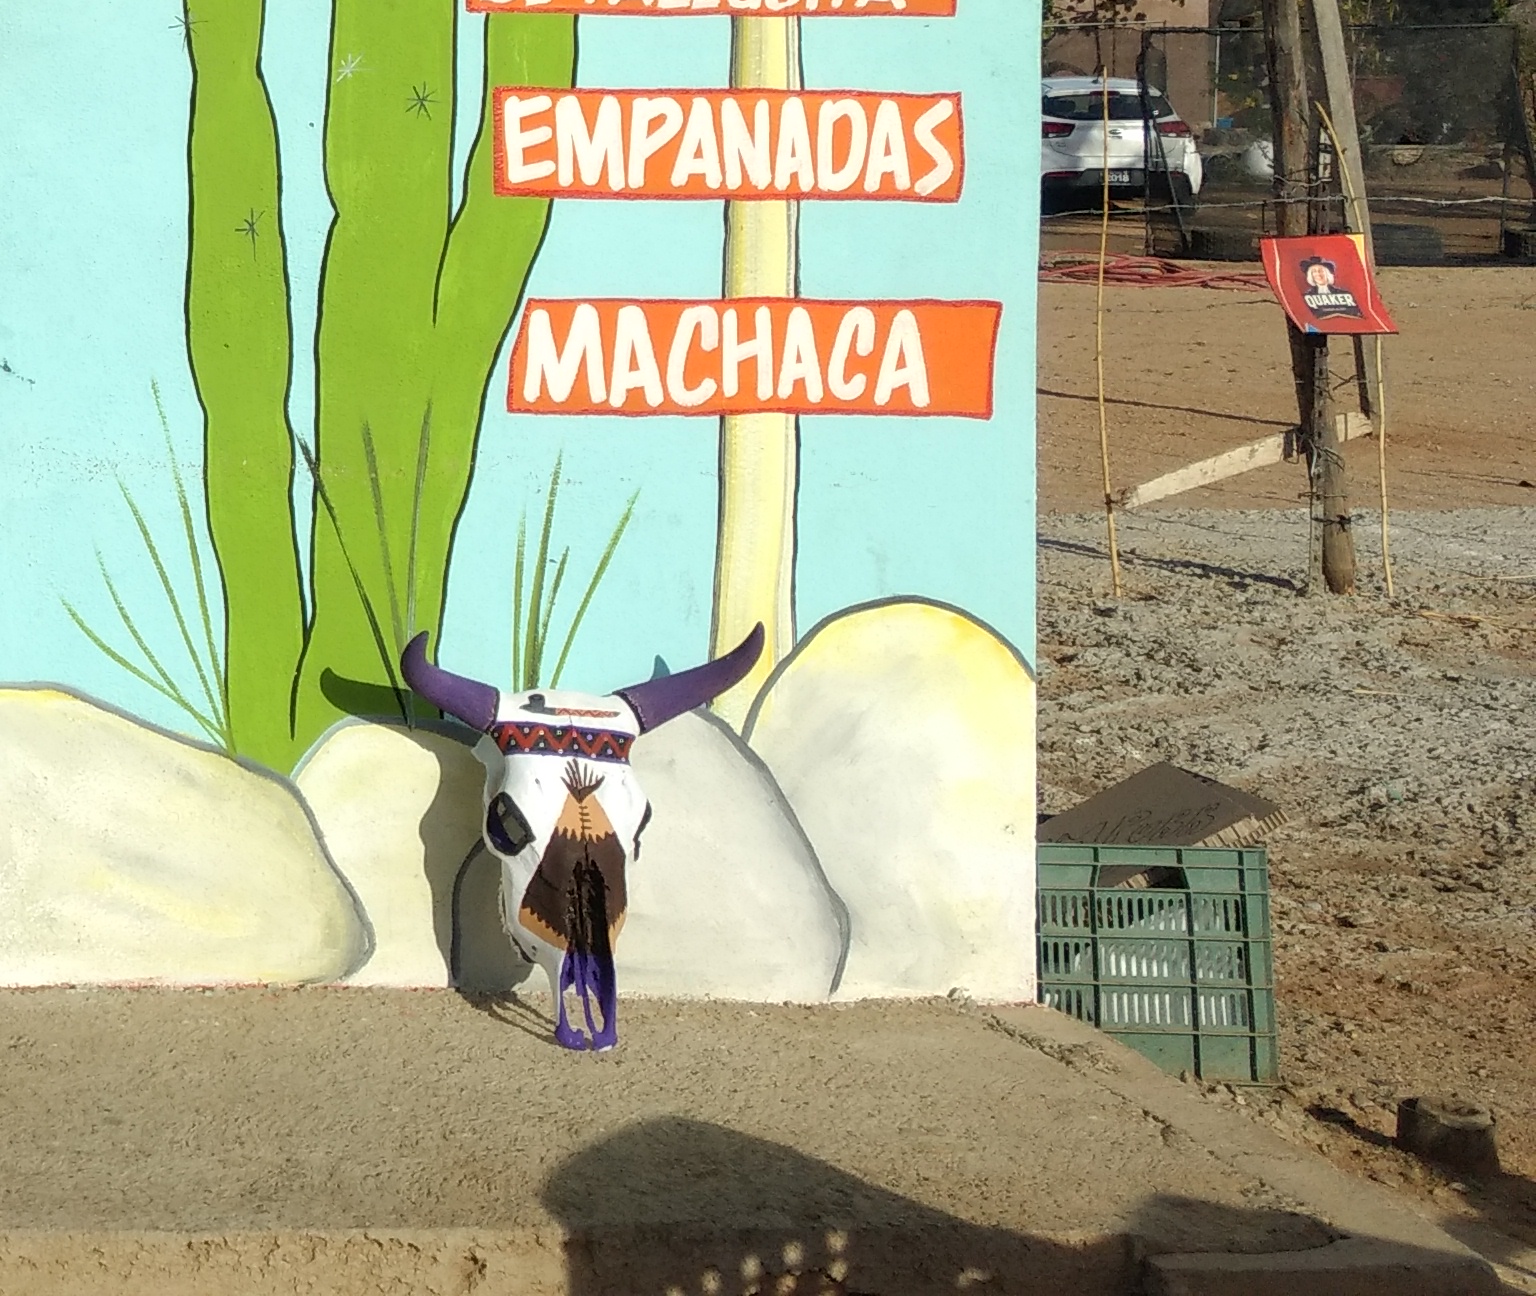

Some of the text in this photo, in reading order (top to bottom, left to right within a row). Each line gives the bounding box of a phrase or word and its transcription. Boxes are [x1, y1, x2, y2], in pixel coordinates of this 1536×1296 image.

[503, 95, 956, 196] EMPANADAS
[1304, 295, 1357, 310] QUAKER
[523, 303, 931, 407] MACHACA
